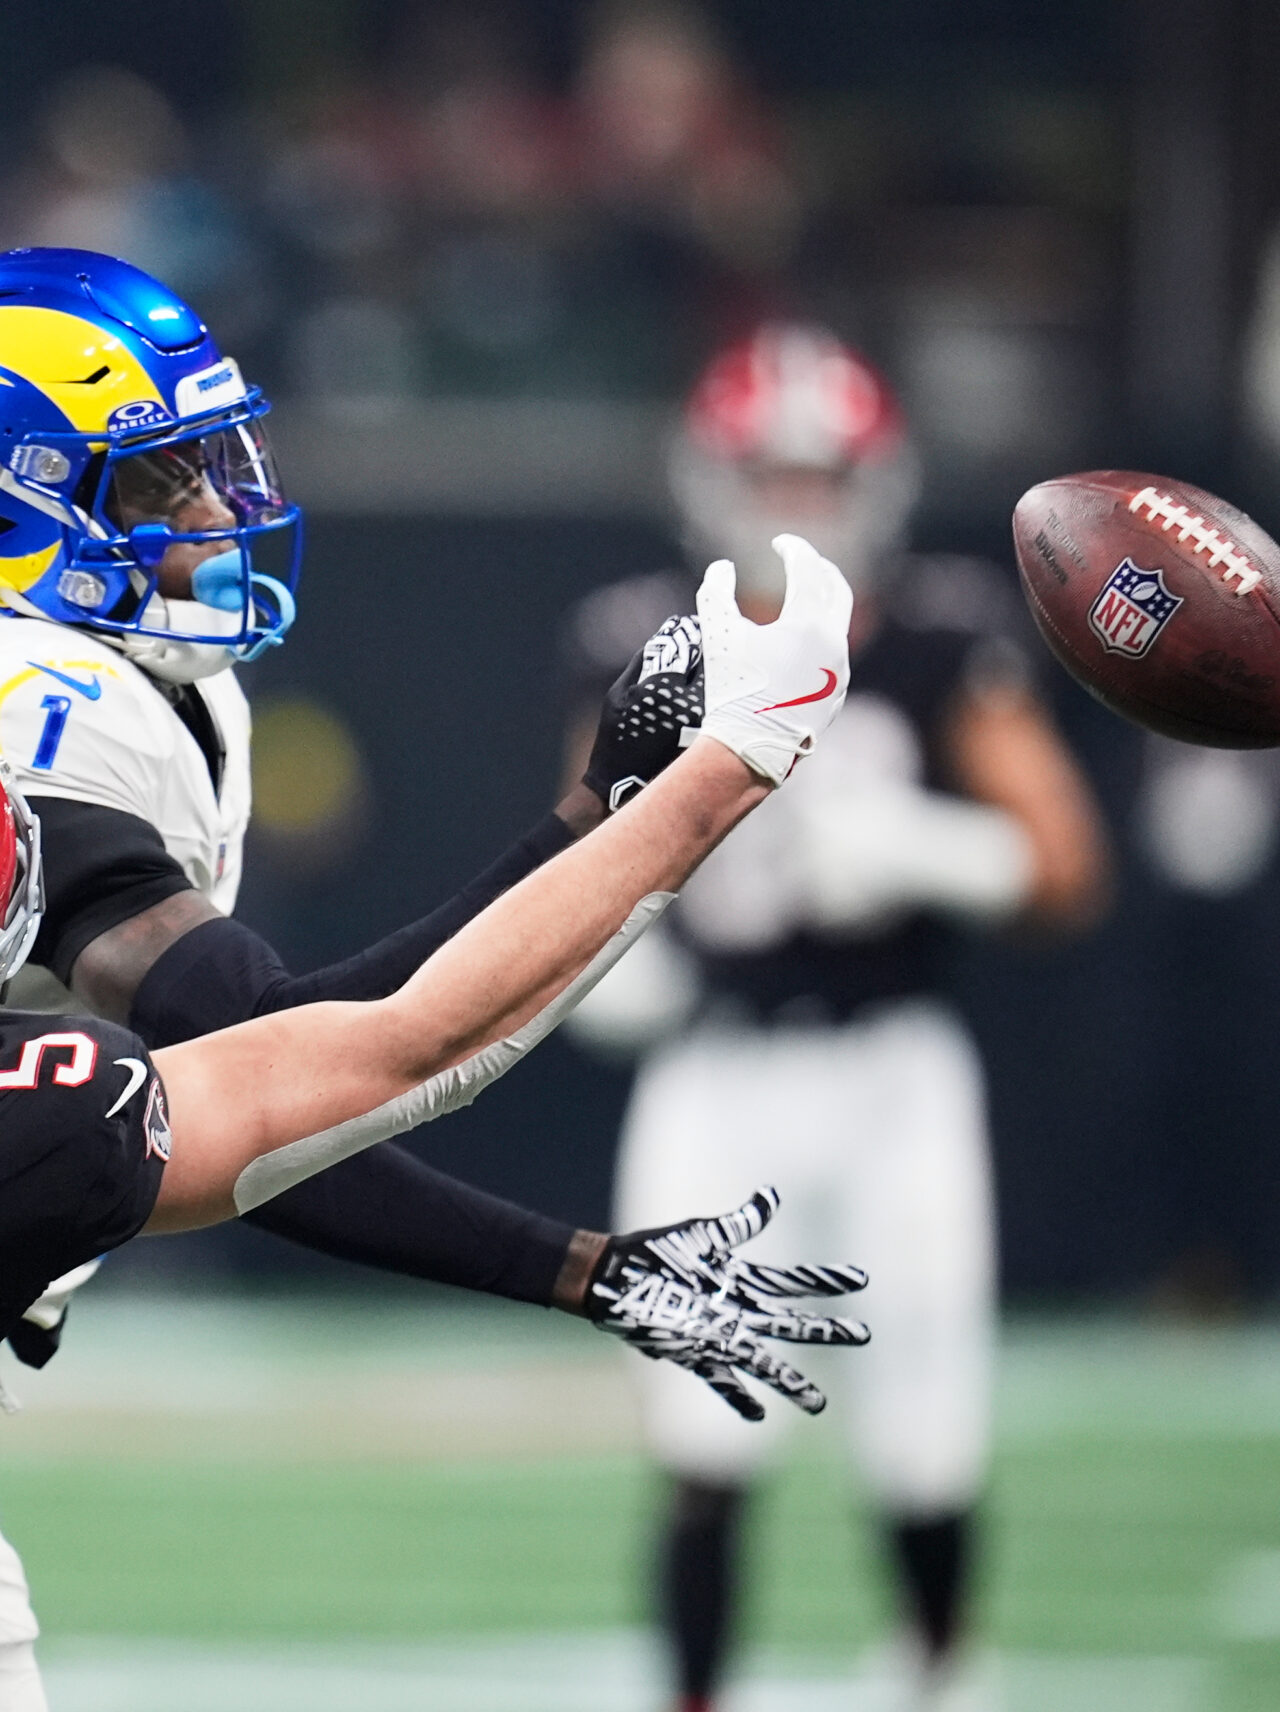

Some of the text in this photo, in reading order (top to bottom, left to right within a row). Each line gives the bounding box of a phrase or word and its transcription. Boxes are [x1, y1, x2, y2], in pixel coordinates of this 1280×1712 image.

[108, 412, 166, 432] OAKLEY
[1095, 591, 1150, 651] NFL
[31, 694, 72, 770] 1
